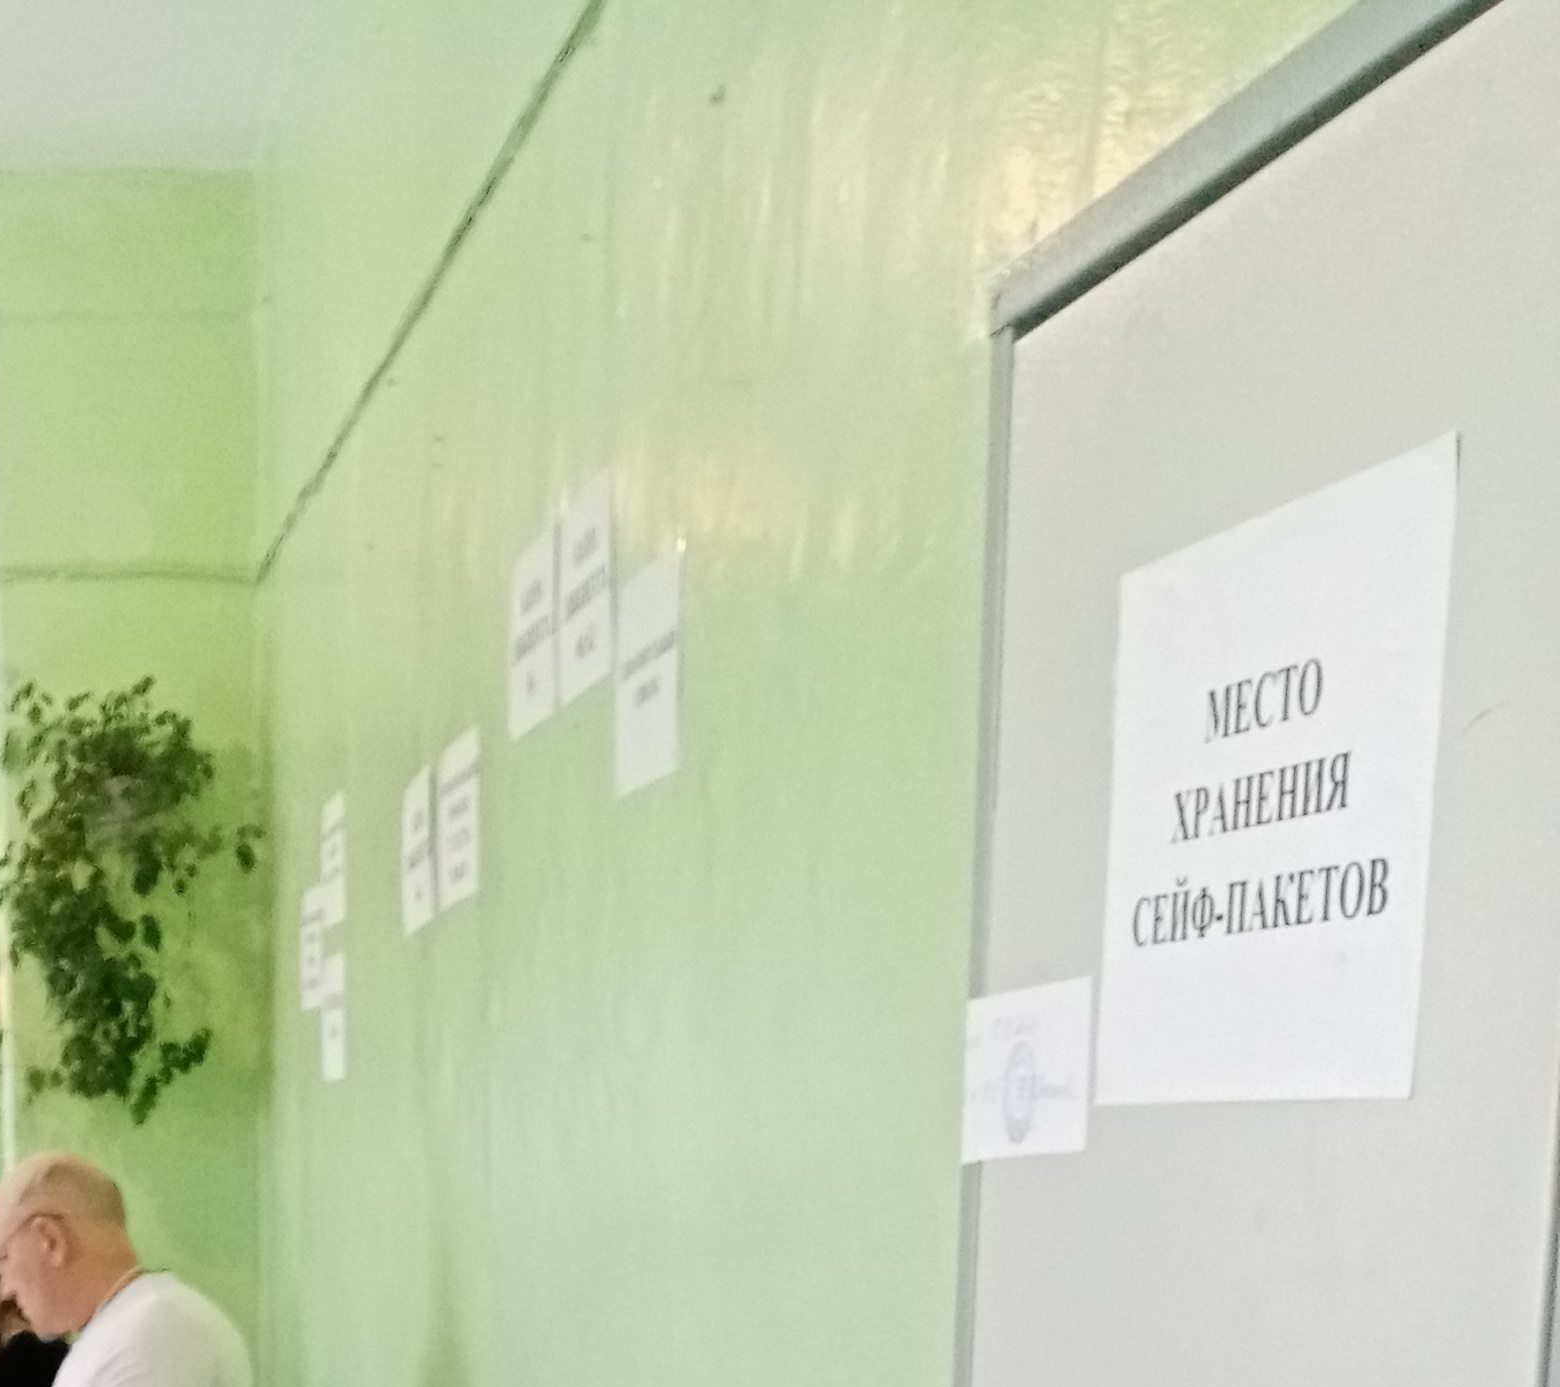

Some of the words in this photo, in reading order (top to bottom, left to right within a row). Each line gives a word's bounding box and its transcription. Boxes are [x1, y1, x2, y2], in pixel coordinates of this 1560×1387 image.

[1203, 657, 1324, 743] МЕСТО
[1170, 750, 1352, 844] ХРАНЕНИЯ
[1132, 857, 1390, 948] СЕЙФ-ПАКЕТОВ
